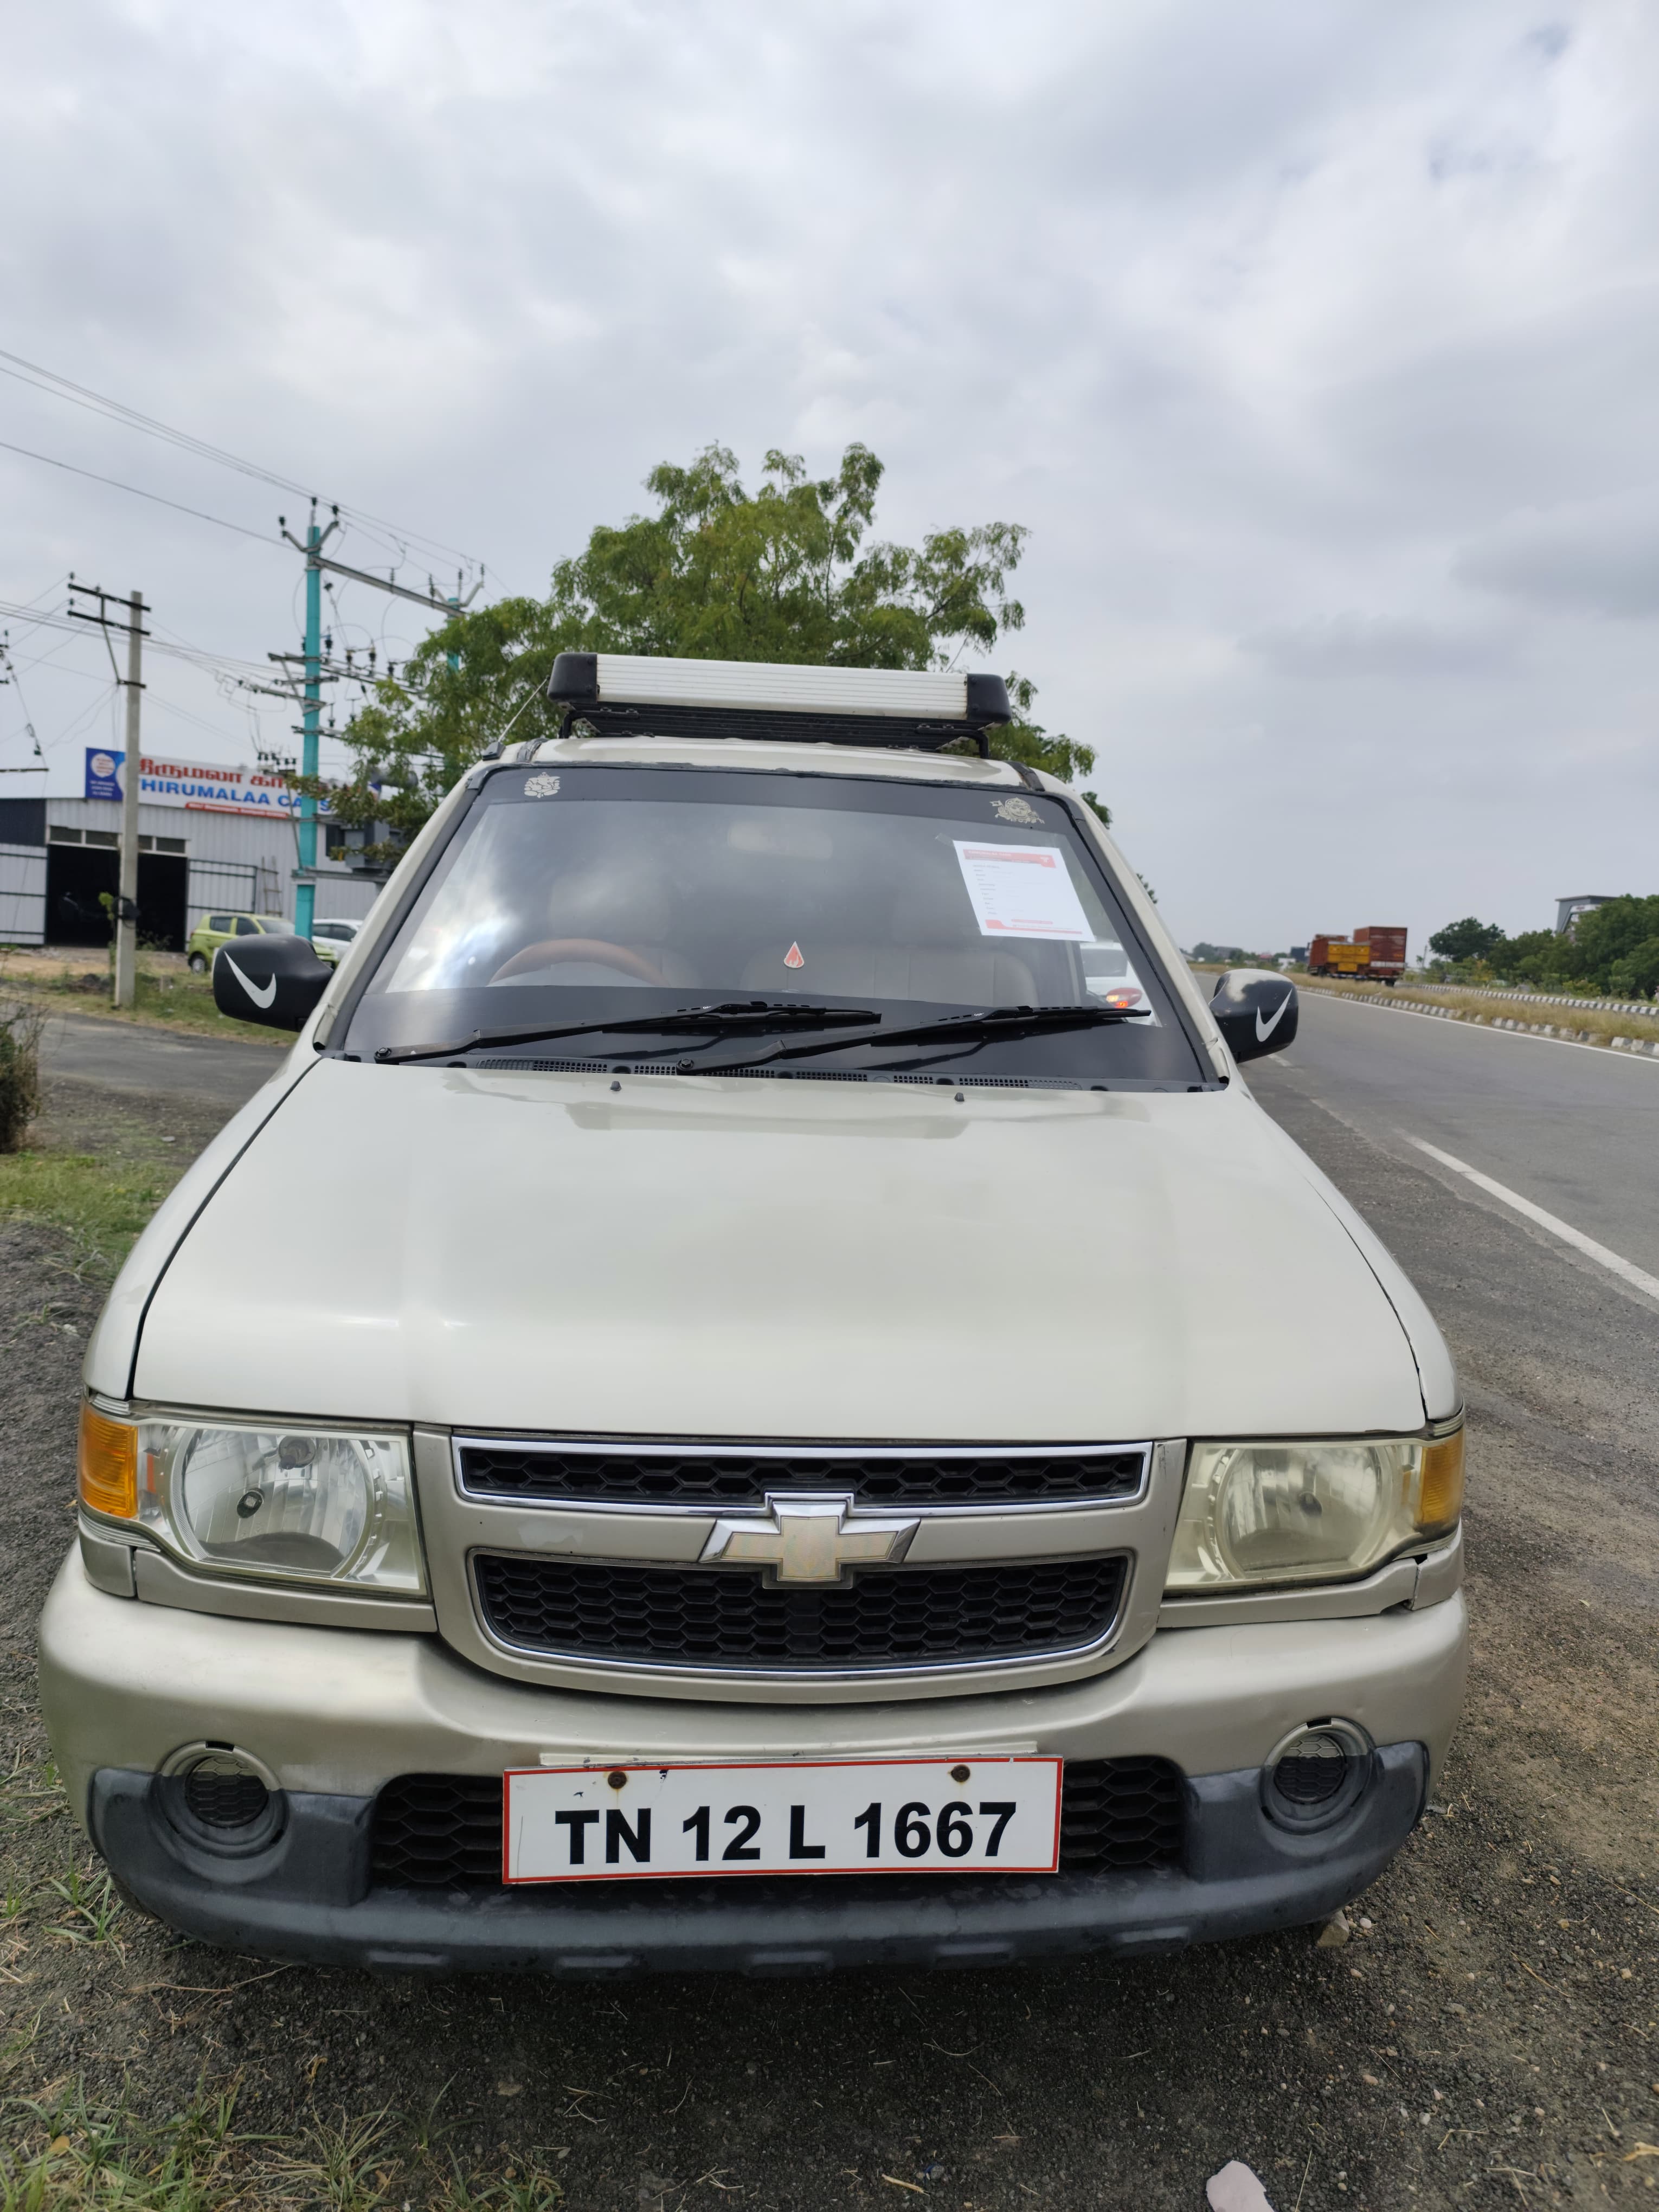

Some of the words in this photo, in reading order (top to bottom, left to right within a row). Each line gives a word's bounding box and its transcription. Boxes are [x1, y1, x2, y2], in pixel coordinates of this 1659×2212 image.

[140, 777, 270, 806] HIRUMALAA
[278, 794, 330, 812] CAS
[555, 1808, 651, 1865] TN
[683, 1805, 761, 1861] 12
[789, 1805, 826, 1860] L
[854, 1801, 1017, 1858] 1667
